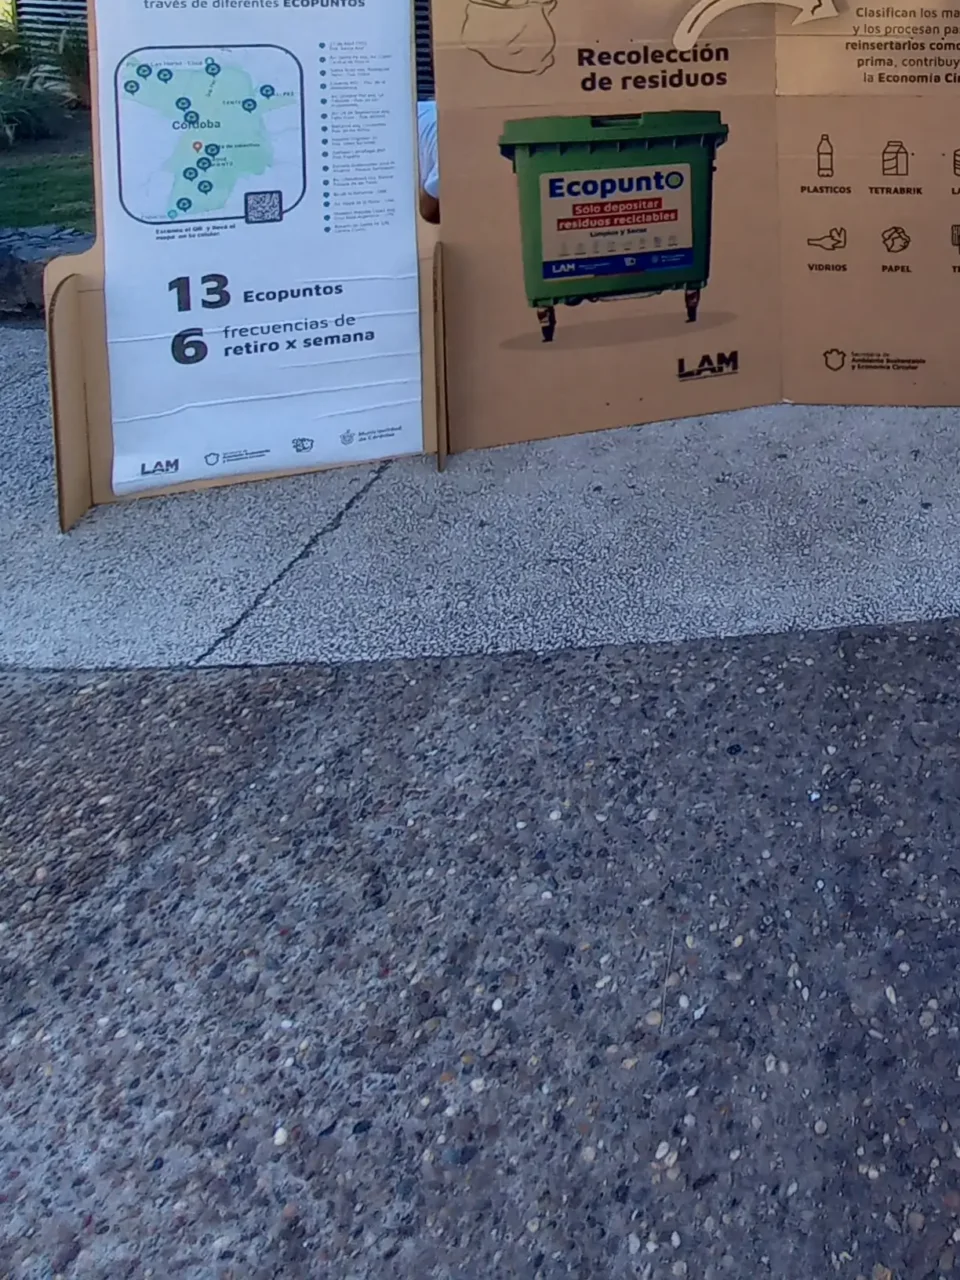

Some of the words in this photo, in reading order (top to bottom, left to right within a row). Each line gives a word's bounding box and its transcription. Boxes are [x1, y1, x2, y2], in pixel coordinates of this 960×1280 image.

[855, 7, 917, 18] Clasifican
[920, 7, 938, 18] los
[852, 25, 861, 36] y
[864, 23, 881, 34] los
[884, 24, 940, 36] procesan
[845, 40, 926, 51] reinsertarlos
[577, 43, 730, 67] Recolección
[856, 57, 898, 69] prima,
[580, 72, 613, 92] de
[621, 68, 728, 90] residuos
[863, 72, 874, 83] la
[549, 171, 684, 199] Ecopunto
[868, 186, 923, 195] TETRABRIK
[603, 200, 659, 213] depositar
[559, 216, 611, 230] residuos
[614, 211, 676, 224] reciclables
[807, 263, 848, 273] VIDRIOS
[881, 264, 912, 273] PAPEL
[168, 273, 232, 313] 13
[243, 283, 344, 304] Ecopuntos
[222, 316, 329, 339] frecuencias
[334, 313, 356, 327] de
[170, 327, 208, 365] 6
[223, 339, 280, 357] retiro
[285, 339, 297, 351] x
[303, 330, 375, 348] semana
[678, 350, 739, 377] LAM
[140, 458, 180, 476] LAM
